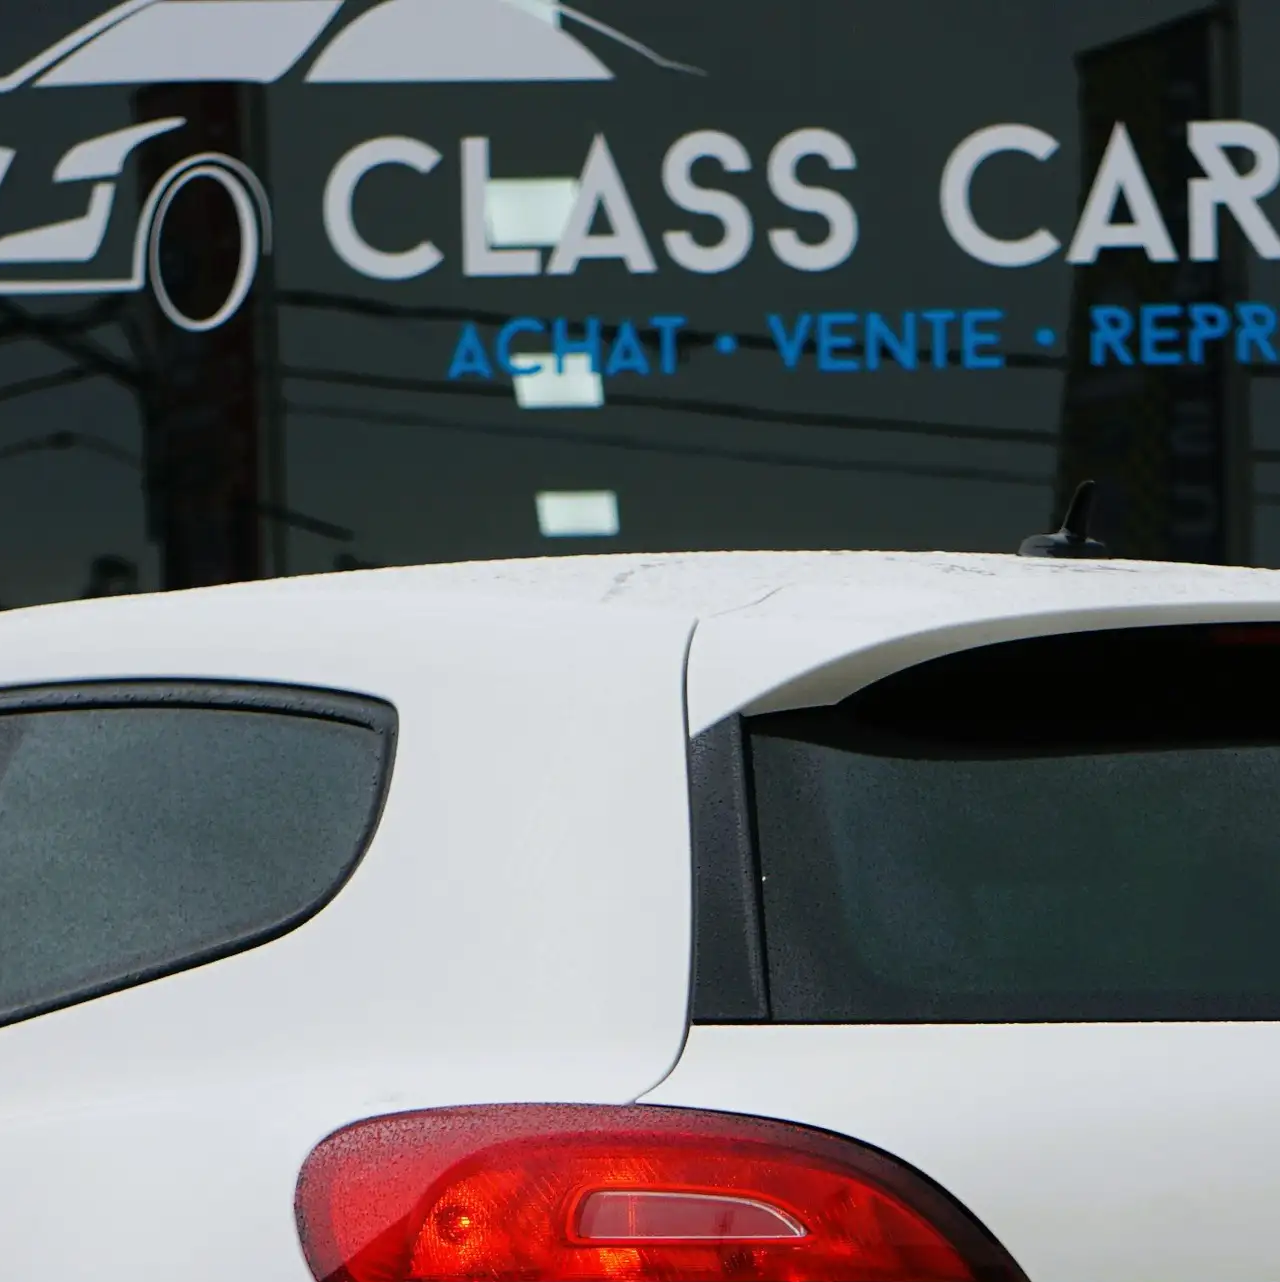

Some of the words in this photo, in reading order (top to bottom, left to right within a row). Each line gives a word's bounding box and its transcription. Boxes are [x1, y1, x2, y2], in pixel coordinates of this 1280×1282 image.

[323, 129, 857, 280] CLASS
[447, 316, 687, 379] ACHAT
[766, 308, 1004, 373] VENTE
